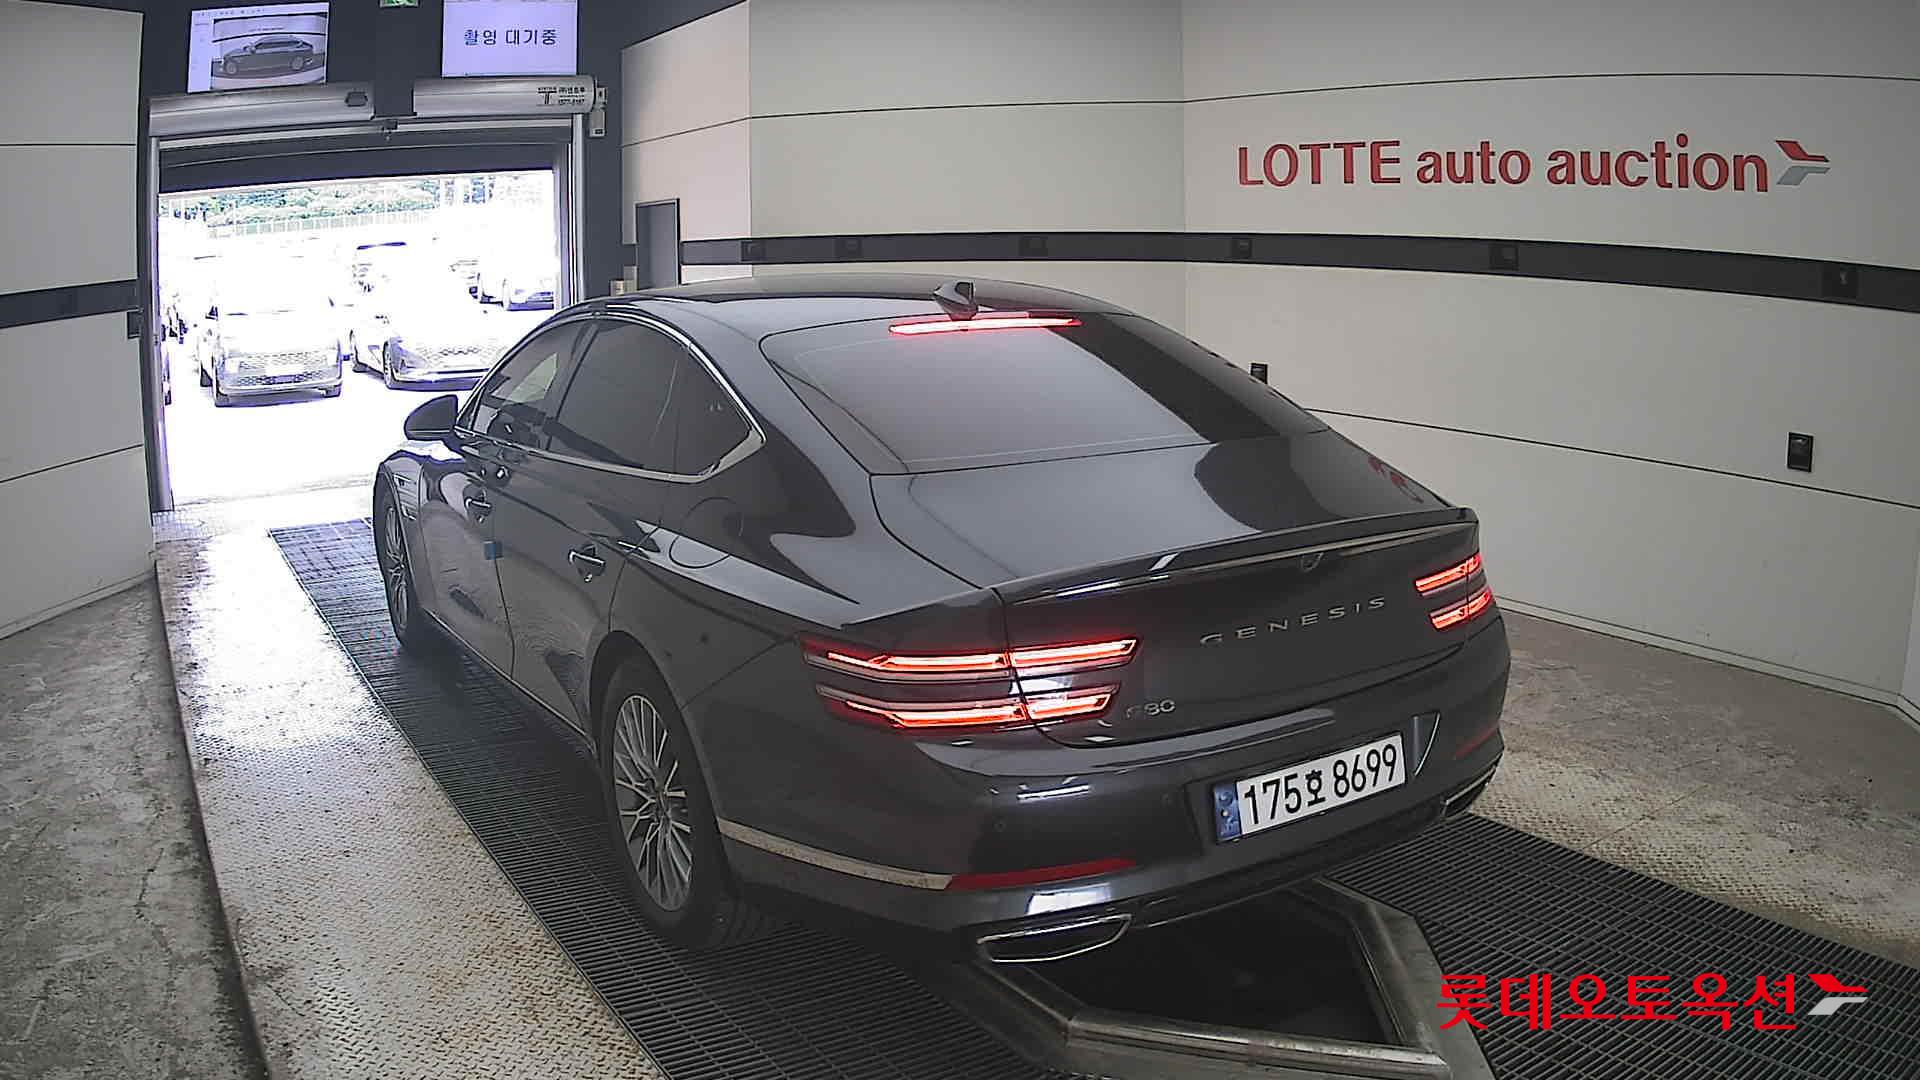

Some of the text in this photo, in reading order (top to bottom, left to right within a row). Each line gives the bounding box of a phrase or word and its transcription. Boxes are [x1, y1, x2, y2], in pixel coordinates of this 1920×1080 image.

[505, 29, 558, 46] 대기중
[1238, 132, 1768, 192] LOTTE auto auction
[1200, 596, 1385, 645] GENESIS
